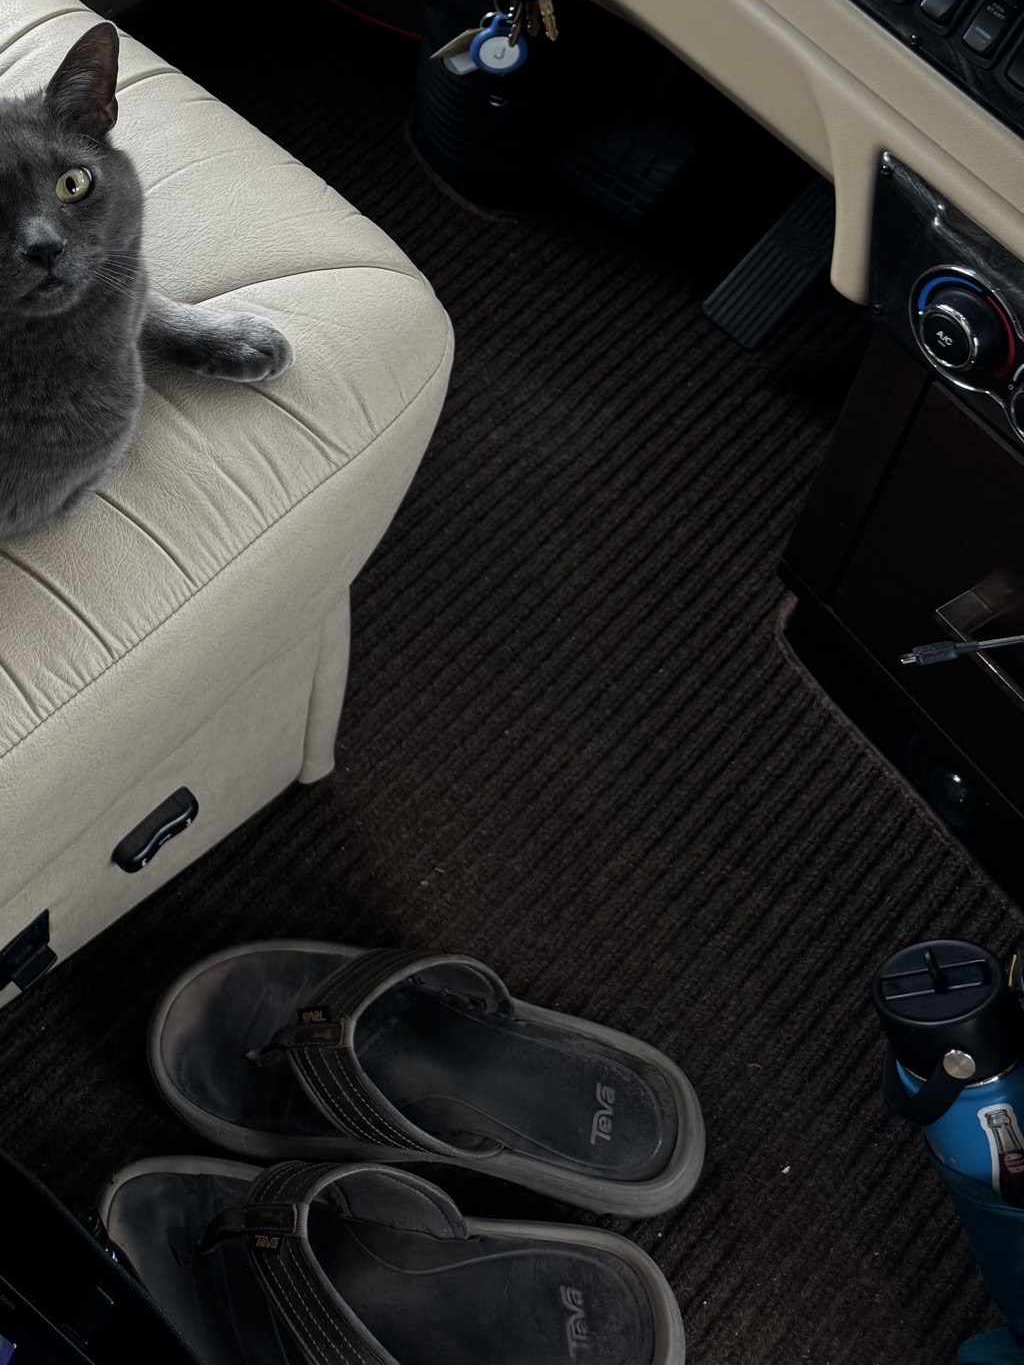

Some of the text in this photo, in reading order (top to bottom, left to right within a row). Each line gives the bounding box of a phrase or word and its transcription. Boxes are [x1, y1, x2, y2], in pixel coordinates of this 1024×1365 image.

[986, 6, 1006, 20] START
[494, 47, 506, 60] J
[936, 330, 954, 346] A/C
[254, 1235, 280, 1249] Teva
